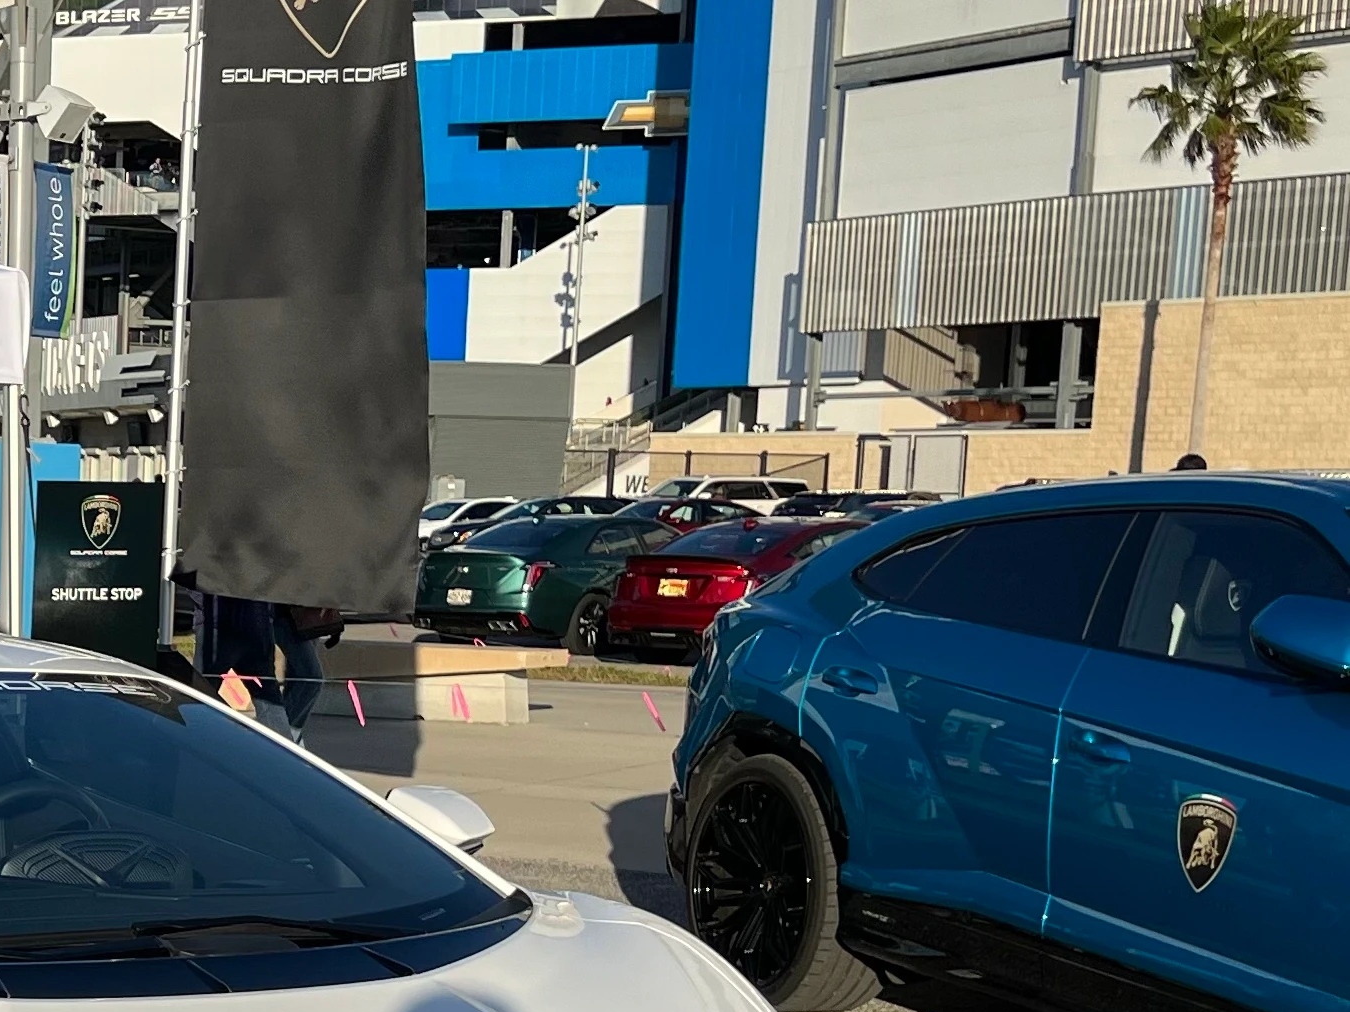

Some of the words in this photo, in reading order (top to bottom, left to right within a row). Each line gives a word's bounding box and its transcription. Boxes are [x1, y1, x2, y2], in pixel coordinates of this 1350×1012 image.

[55, 8, 140, 25] BLAZER
[221, 67, 339, 84] SQUADRA
[342, 60, 408, 83] CORSE
[47, 176, 64, 262] whole
[44, 269, 64, 323] feel
[51, 587, 108, 601] SHUTTLE
[110, 587, 143, 601] STOP
